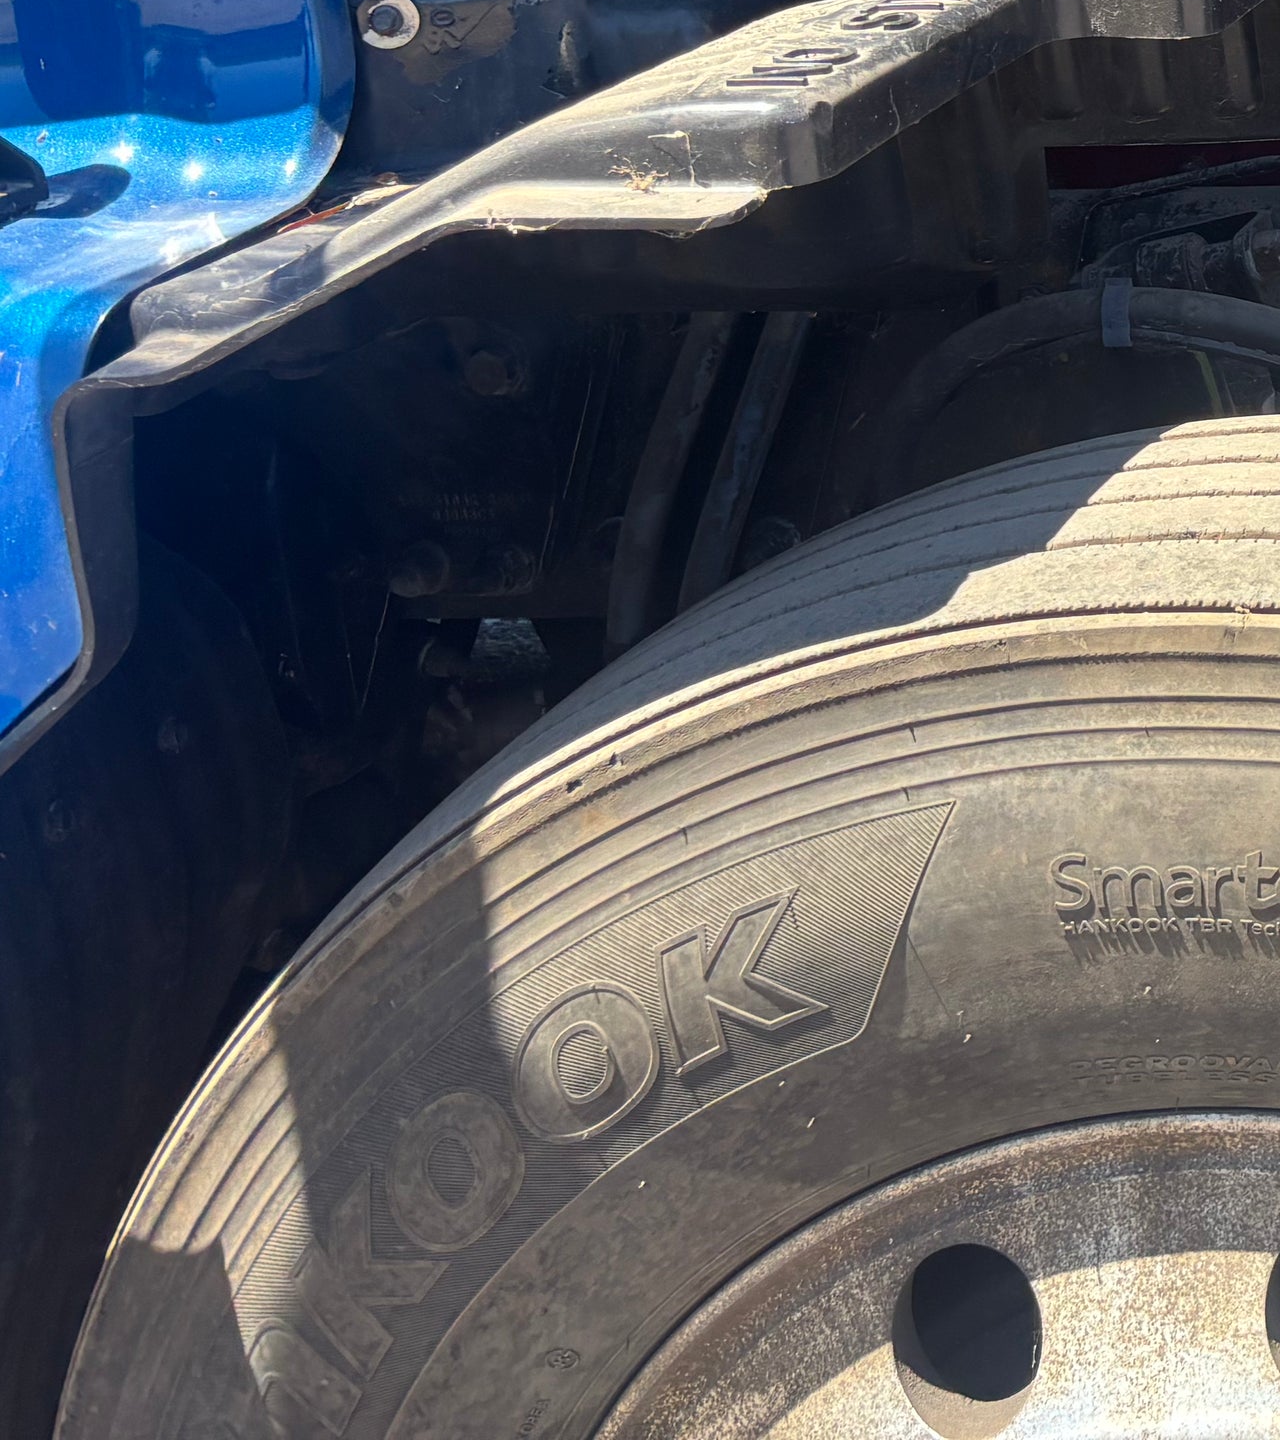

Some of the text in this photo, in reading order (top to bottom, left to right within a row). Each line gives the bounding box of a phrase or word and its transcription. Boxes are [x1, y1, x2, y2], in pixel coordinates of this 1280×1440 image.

[725, 46, 860, 88] NO
[1059, 916, 1181, 936] HANKOOK
[1184, 917, 1234, 934] TBR
